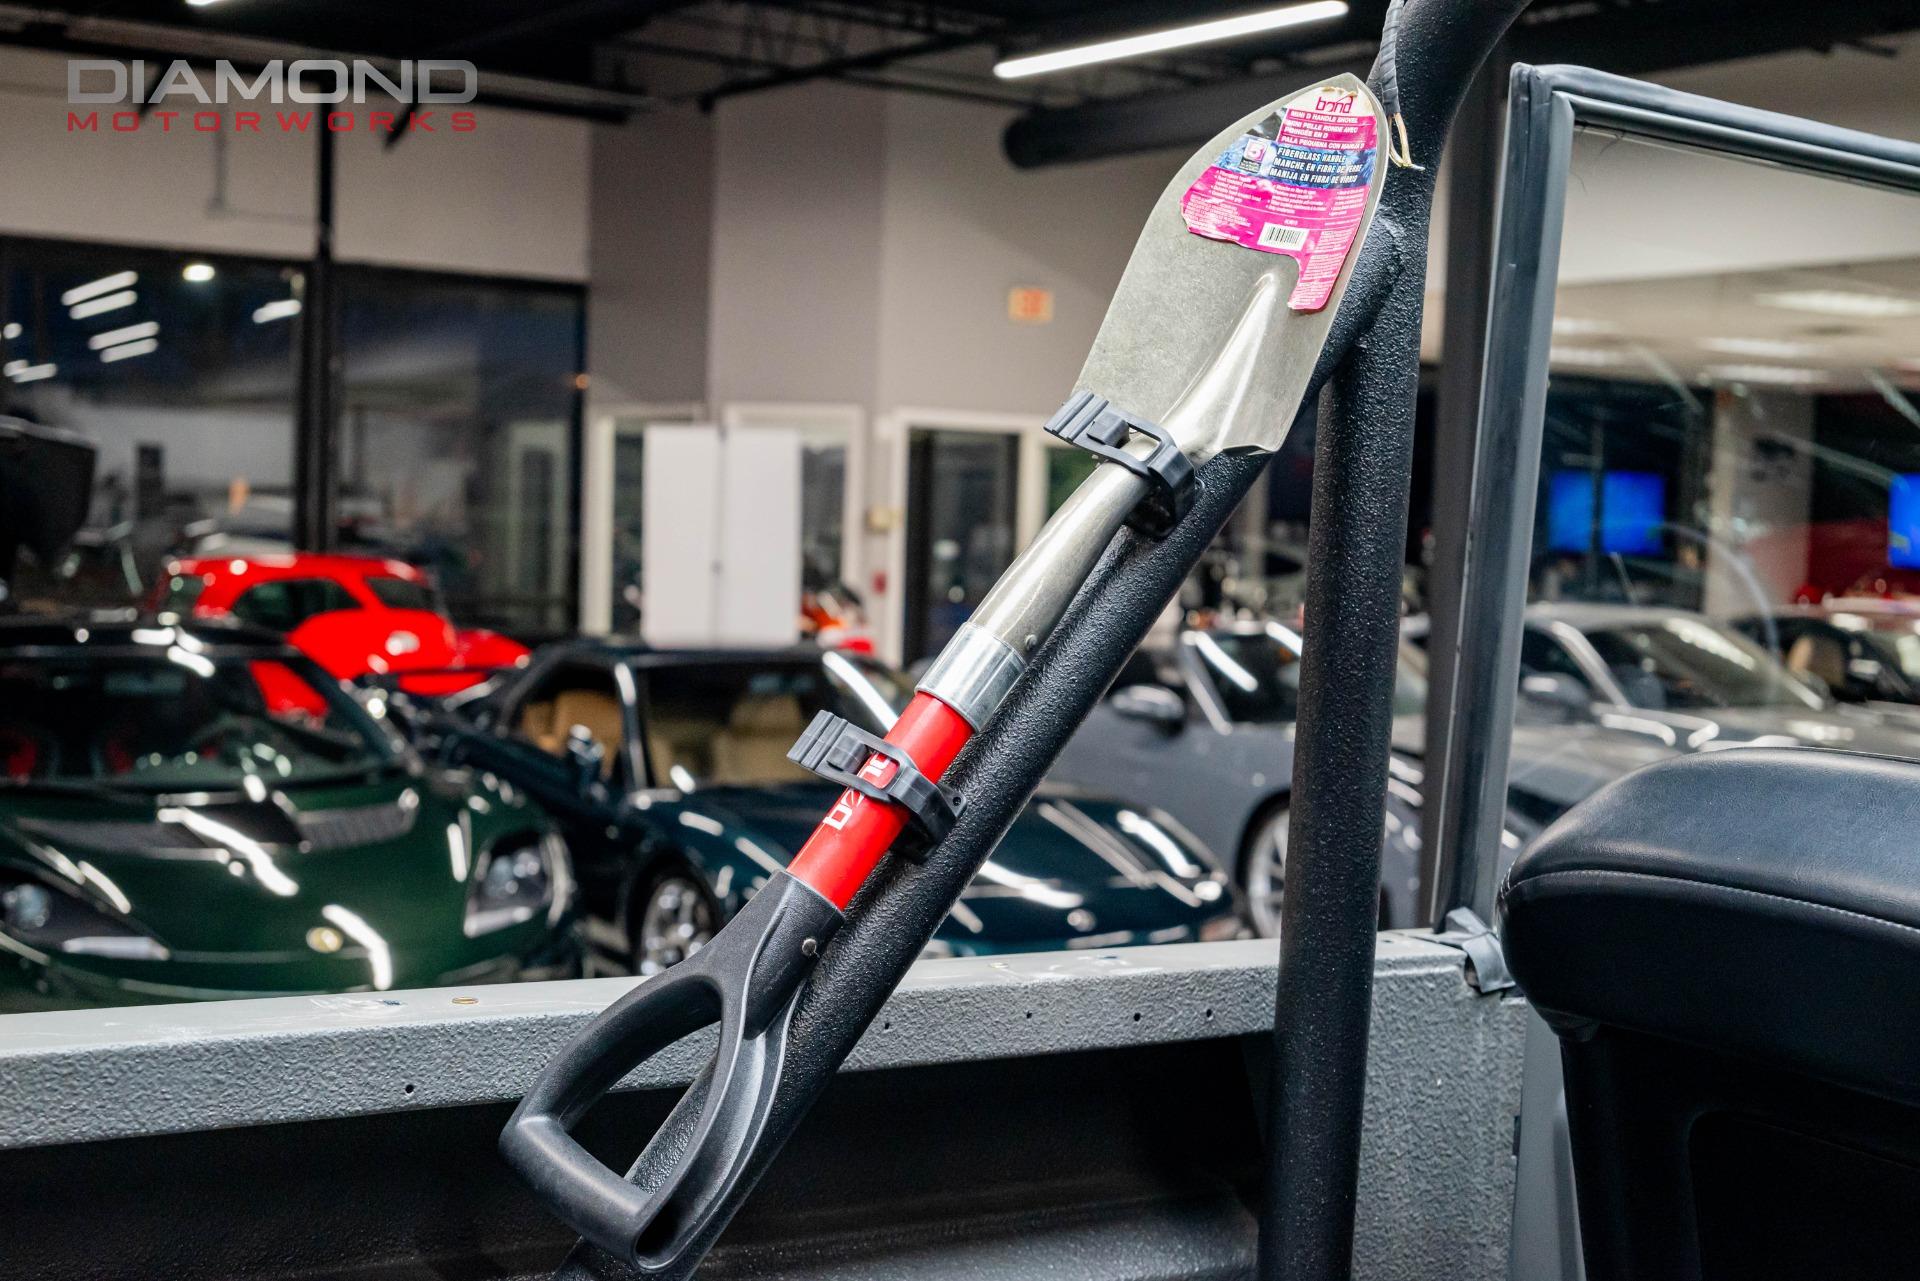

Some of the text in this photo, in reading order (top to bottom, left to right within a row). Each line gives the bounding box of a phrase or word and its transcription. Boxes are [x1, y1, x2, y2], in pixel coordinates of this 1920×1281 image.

[1315, 95, 1354, 114] bond
[1312, 113, 1337, 122] HANDLE
[1313, 130, 1322, 138] EN
[1281, 136, 1298, 144] PALA
[1328, 141, 1341, 149] CON
[1277, 147, 1347, 163] FIBERGLASS HANDLE
[1273, 158, 1305, 170] MANCHE
[1305, 162, 1316, 171] EN
[1316, 163, 1336, 173] FIBRE
[1336, 164, 1346, 173] DE
[1269, 167, 1298, 180] MANIJA
[1299, 173, 1309, 182] EN
[1310, 174, 1330, 183] FIBRA
[1330, 174, 1340, 183] DE
